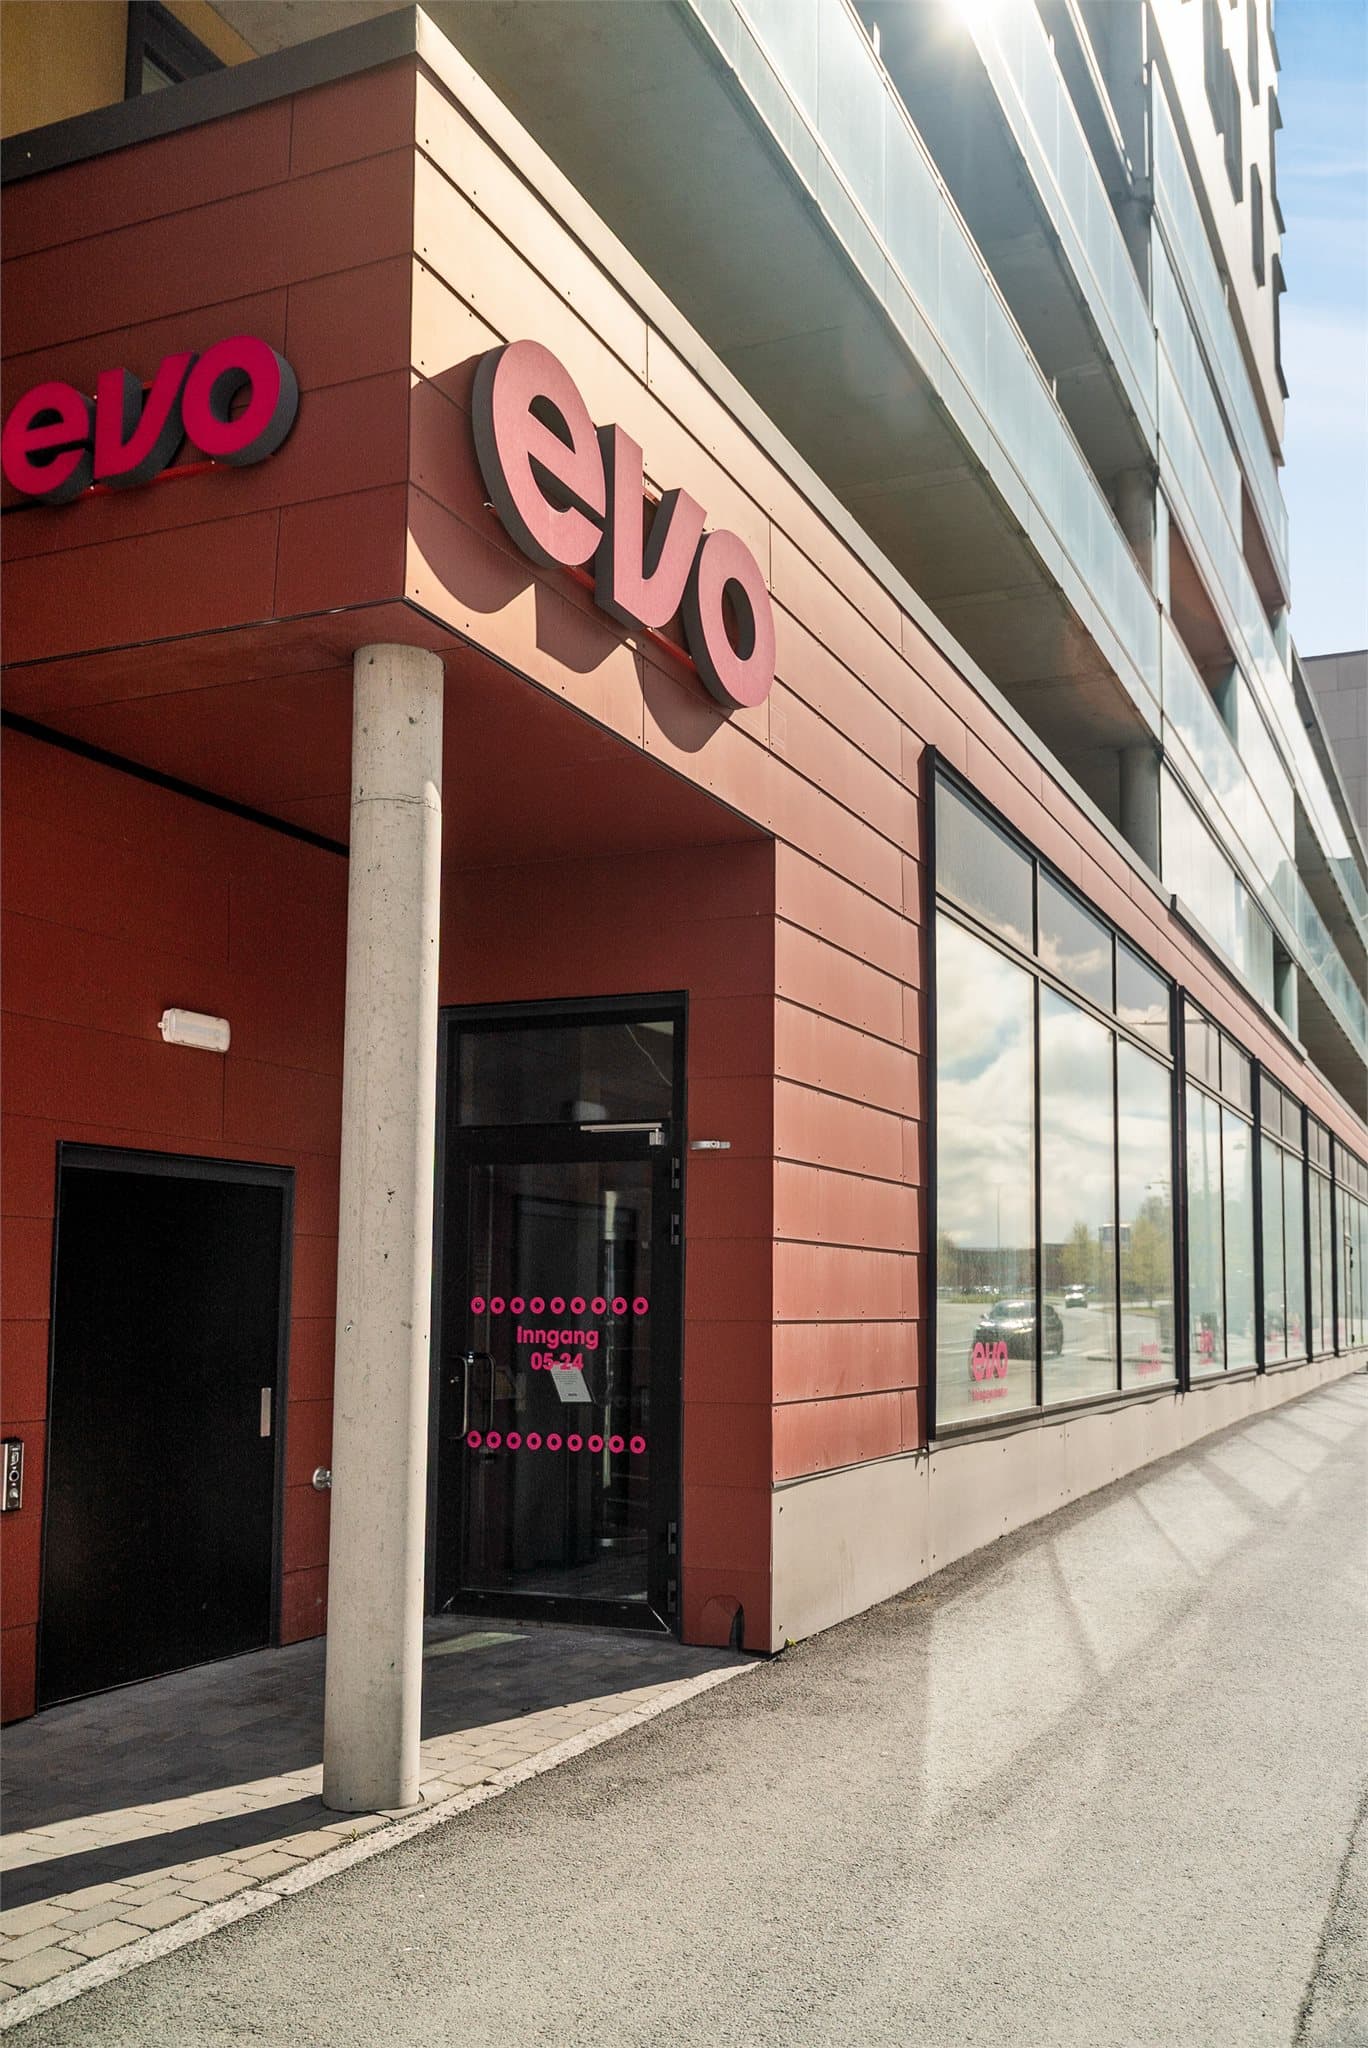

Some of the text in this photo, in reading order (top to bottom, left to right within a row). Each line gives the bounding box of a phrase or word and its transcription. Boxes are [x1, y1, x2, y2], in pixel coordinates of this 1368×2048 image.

[2, 336, 290, 500] evo
[485, 340, 776, 708] evo
[516, 1326, 600, 1350] Inngang
[530, 1352, 584, 1371] 05-24
[973, 1341, 1008, 1382] evo
